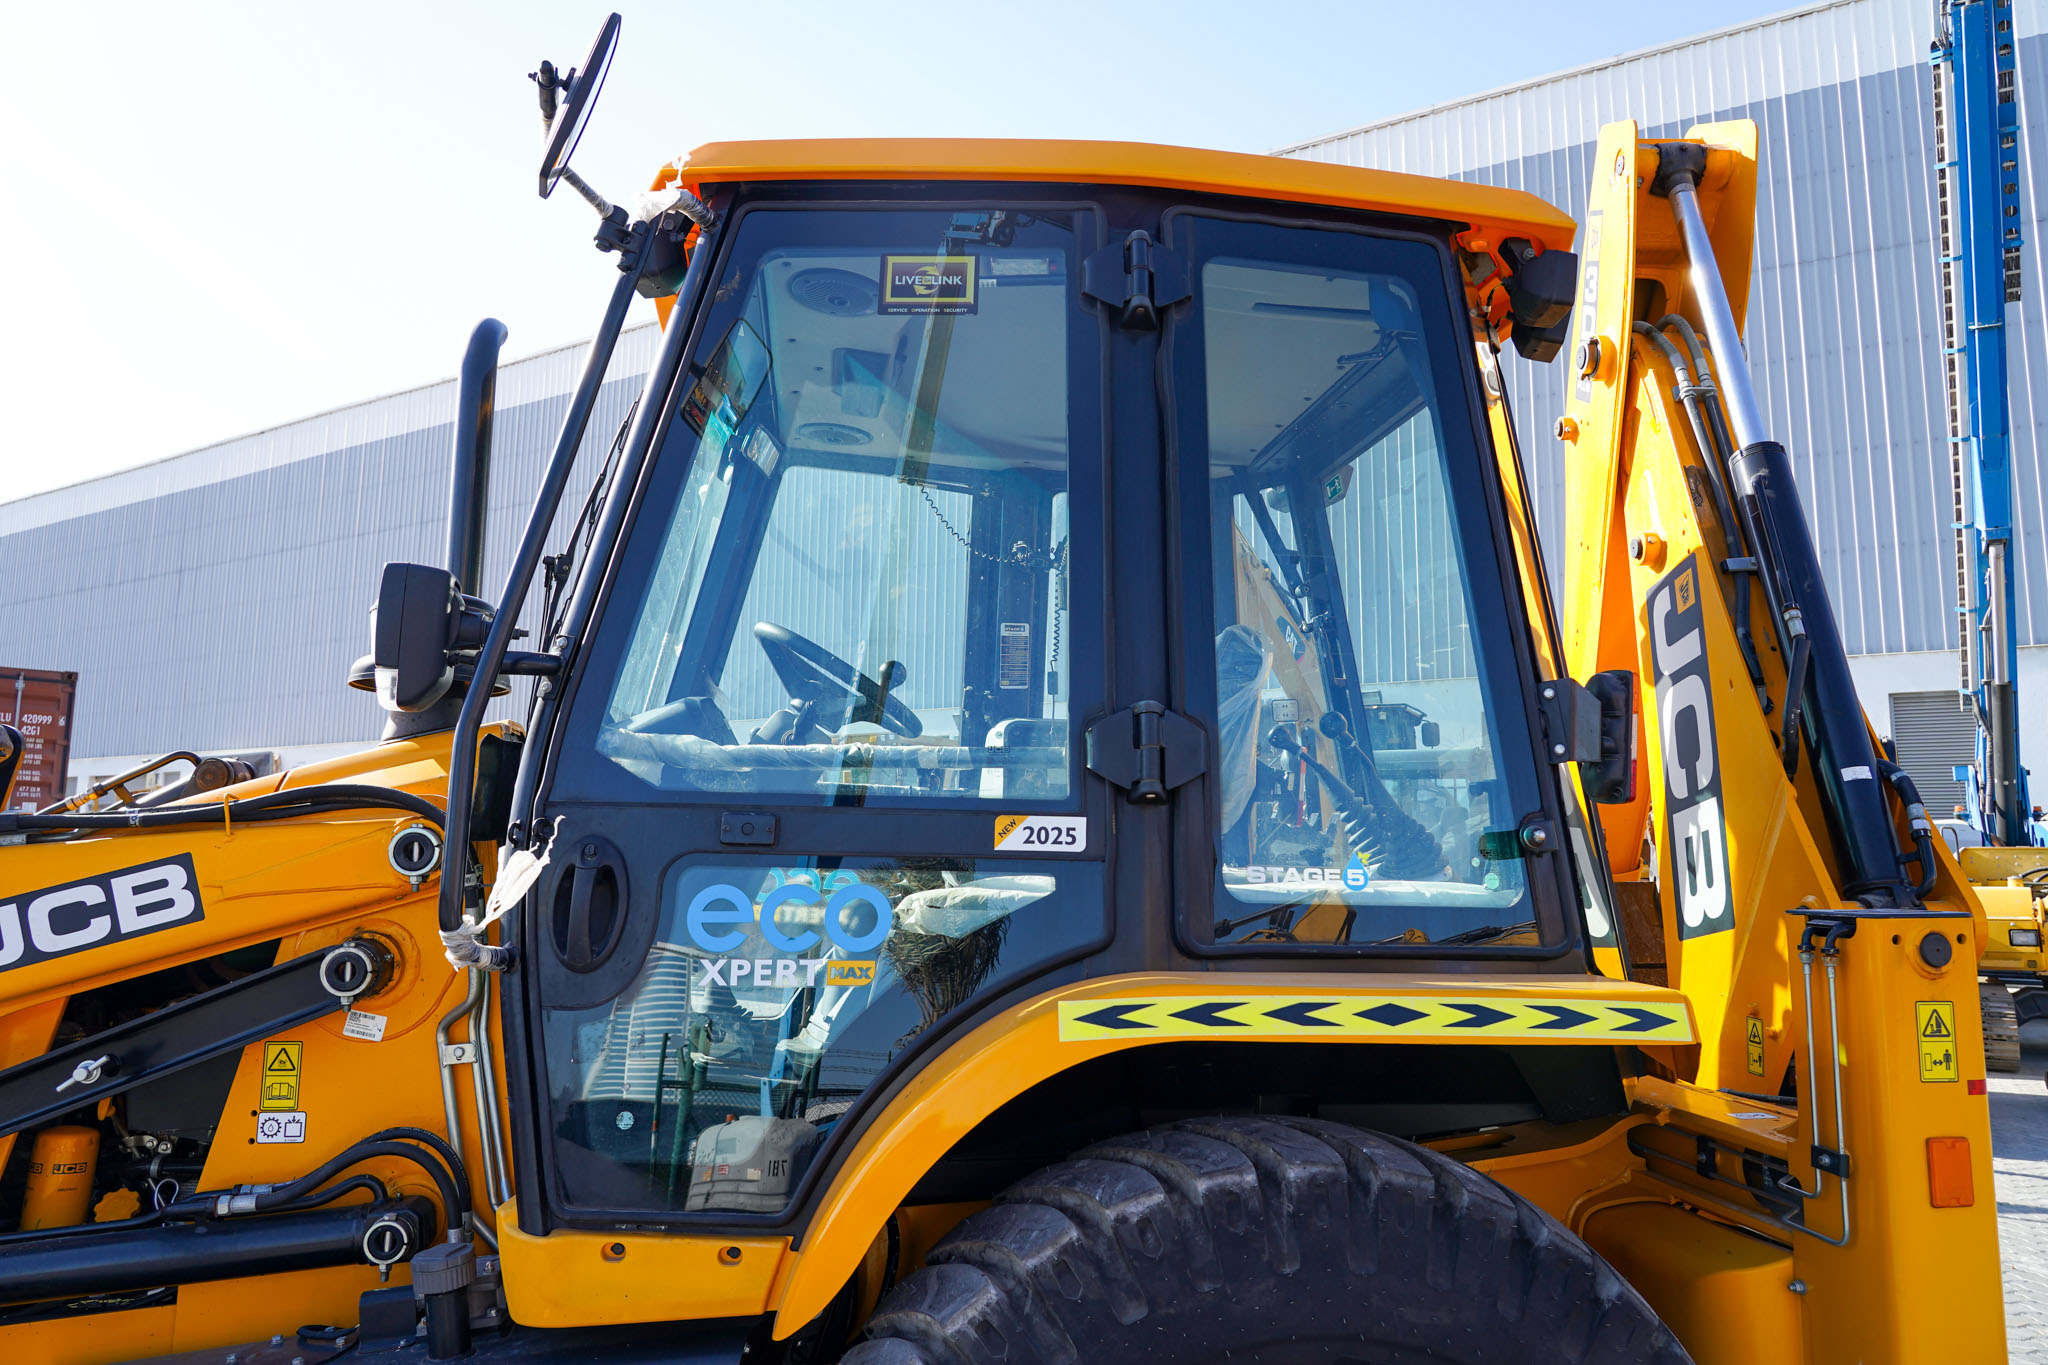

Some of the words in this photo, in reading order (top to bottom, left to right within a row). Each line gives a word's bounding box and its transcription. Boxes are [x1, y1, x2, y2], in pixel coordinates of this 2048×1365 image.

[0, 712, 12, 722] LU
[22, 713, 53, 725] 420999
[1653, 585, 1727, 928] JCB
[998, 818, 1017, 838] NEW
[1022, 826, 1077, 845] 2025
[1247, 866, 1342, 883] STAGE
[1346, 869, 1365, 886] 5
[687, 884, 893, 952] eco
[698, 959, 824, 987] XPERT
[830, 966, 873, 980] MAX
[53, 1163, 86, 1174] JCB
